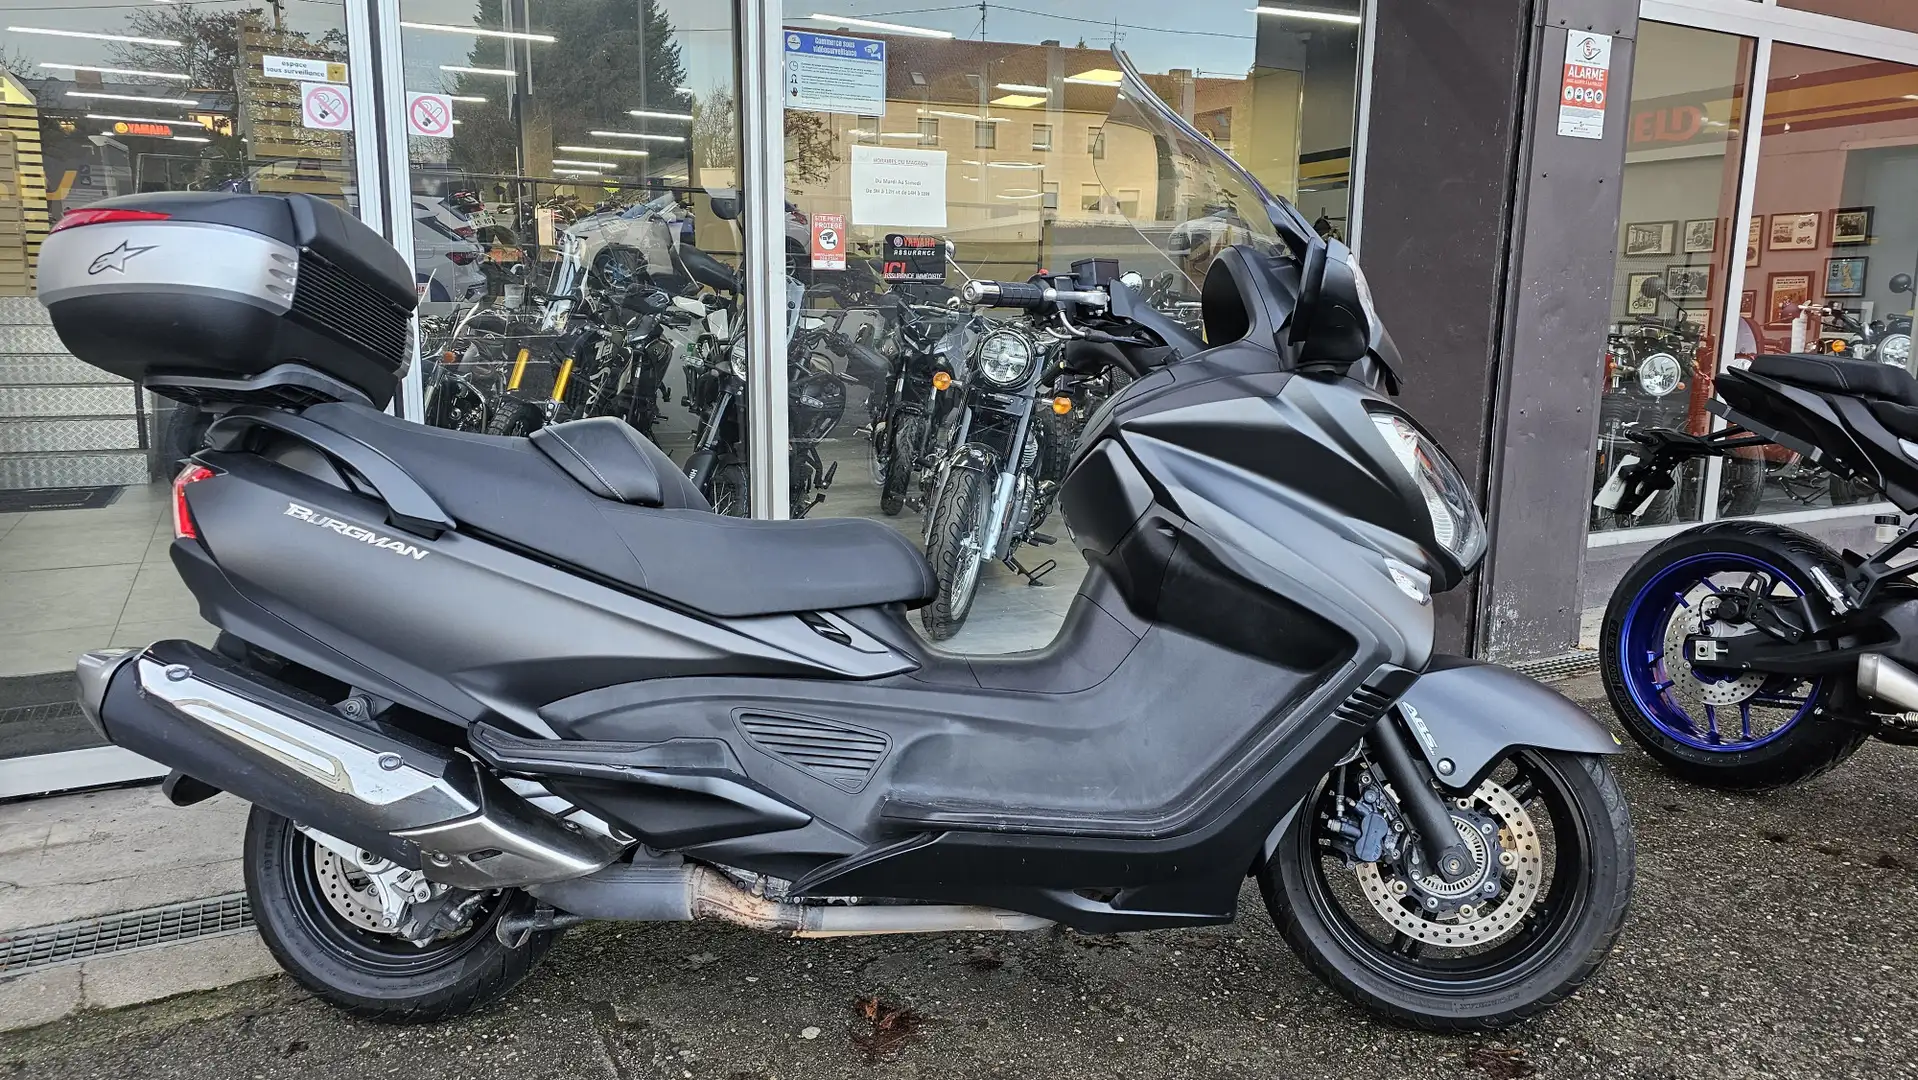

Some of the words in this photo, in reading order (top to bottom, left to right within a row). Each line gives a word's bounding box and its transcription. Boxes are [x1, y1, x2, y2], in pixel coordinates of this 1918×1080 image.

[815, 37, 841, 46] Commerce
[843, 40, 855, 48] sous
[284, 68, 325, 77] surveillance
[1568, 65, 1605, 81] ALARME
[127, 123, 171, 136] YAMAHA
[903, 236, 936, 247] YAMAHA
[884, 261, 906, 274] ICI
[283, 502, 429, 560] BURGMAN
[1402, 701, 1438, 753] ABS
